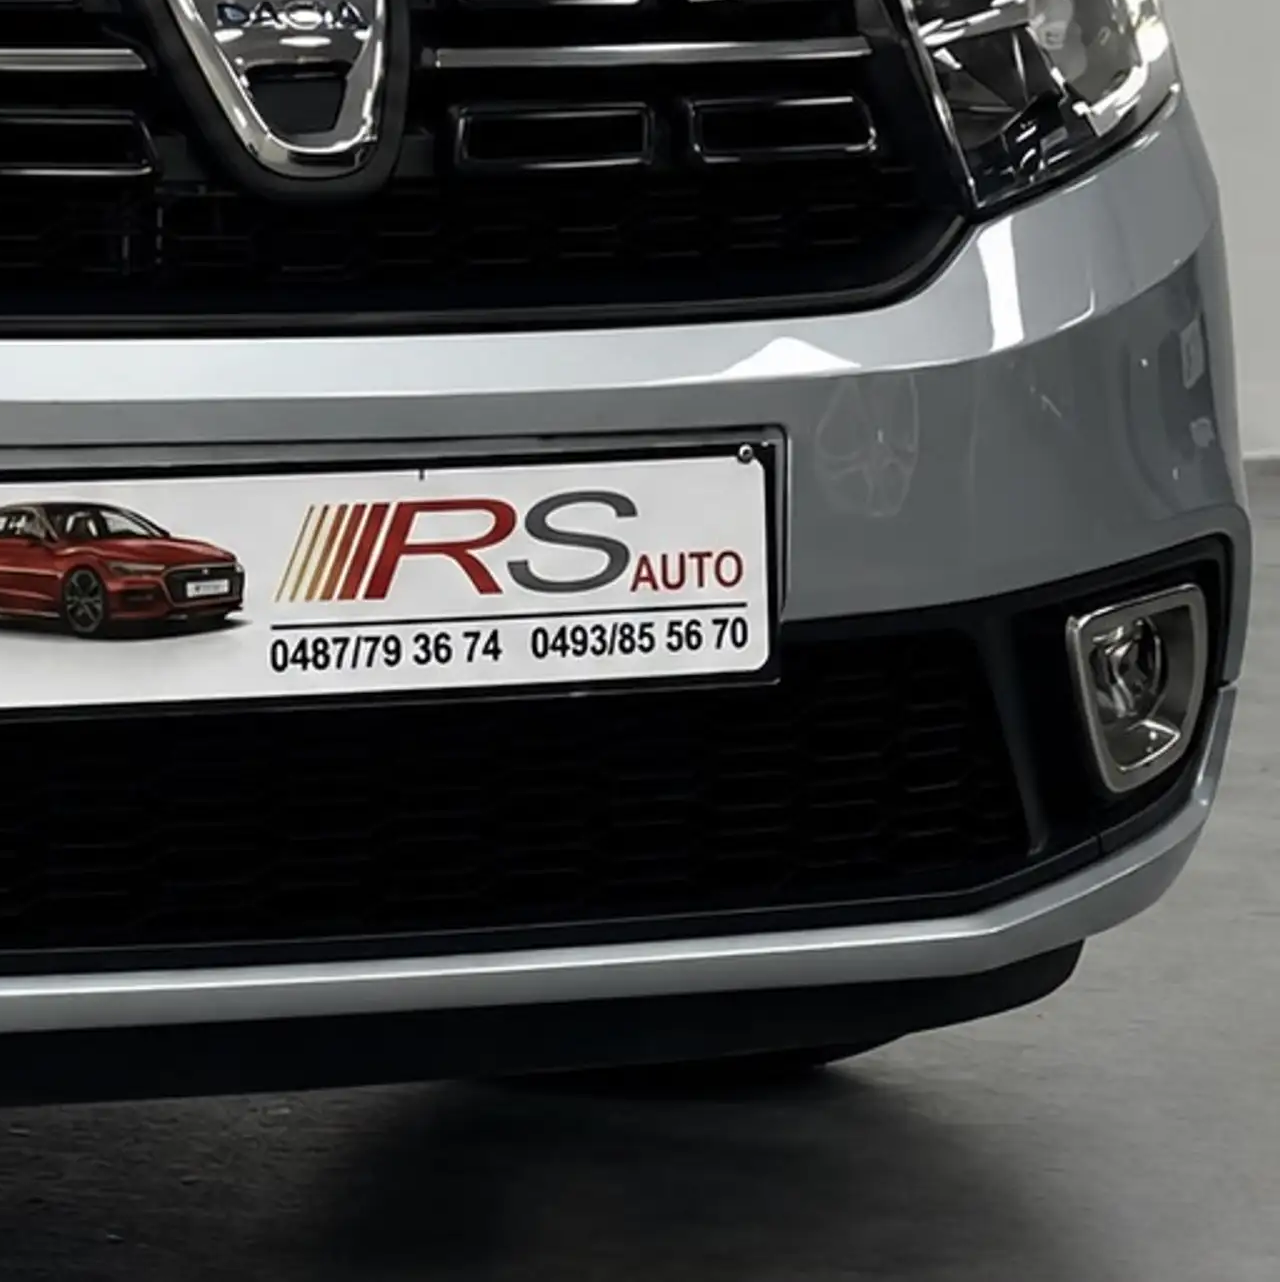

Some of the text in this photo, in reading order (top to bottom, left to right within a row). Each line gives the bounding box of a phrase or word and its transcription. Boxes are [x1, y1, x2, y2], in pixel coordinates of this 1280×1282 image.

[215, 0, 370, 30] DACIA
[363, 489, 744, 601] RS AUTO
[269, 616, 749, 673] 0487/79 36 74 0493/85 56 70
